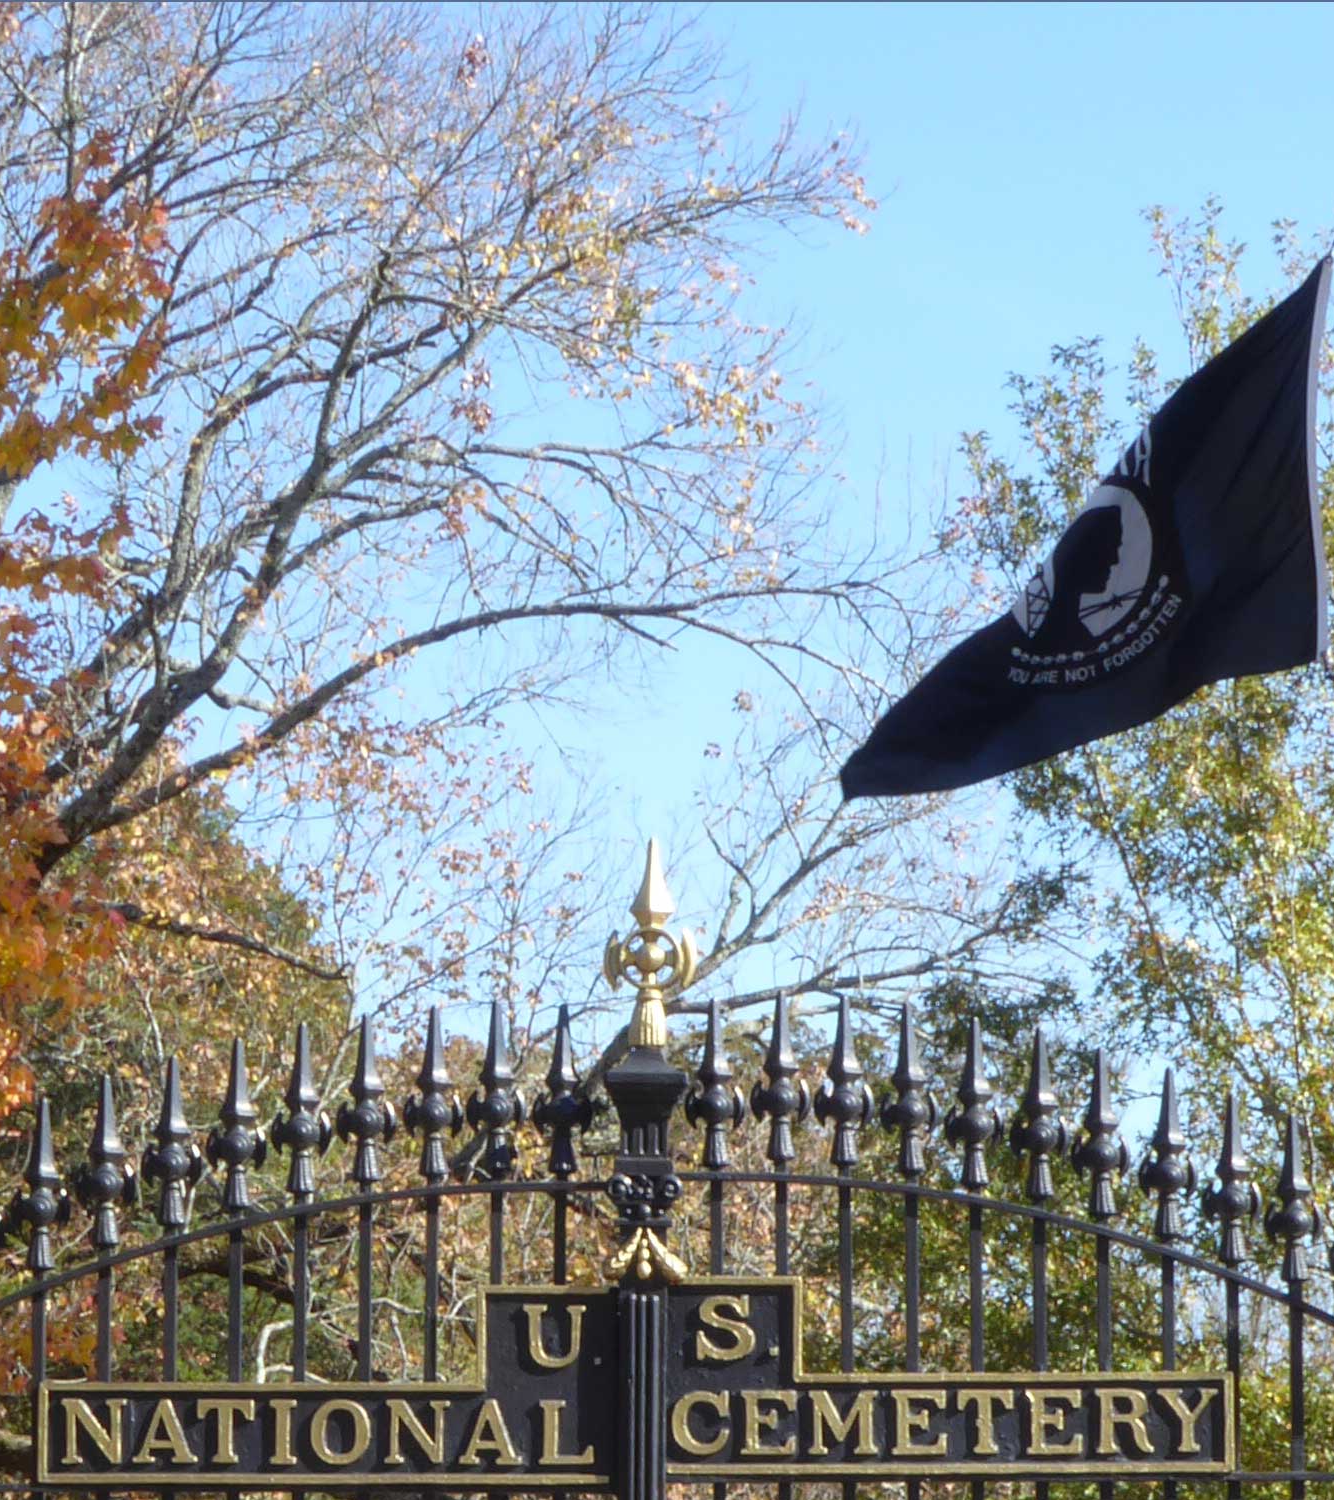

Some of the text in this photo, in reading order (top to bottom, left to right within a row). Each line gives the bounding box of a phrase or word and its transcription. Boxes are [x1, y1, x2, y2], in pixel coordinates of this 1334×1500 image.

[1008, 593, 1183, 686] YOU ARE NOT FORGOTTEN
[60, 1387, 1219, 1467] NATIONAL CEMETERY
